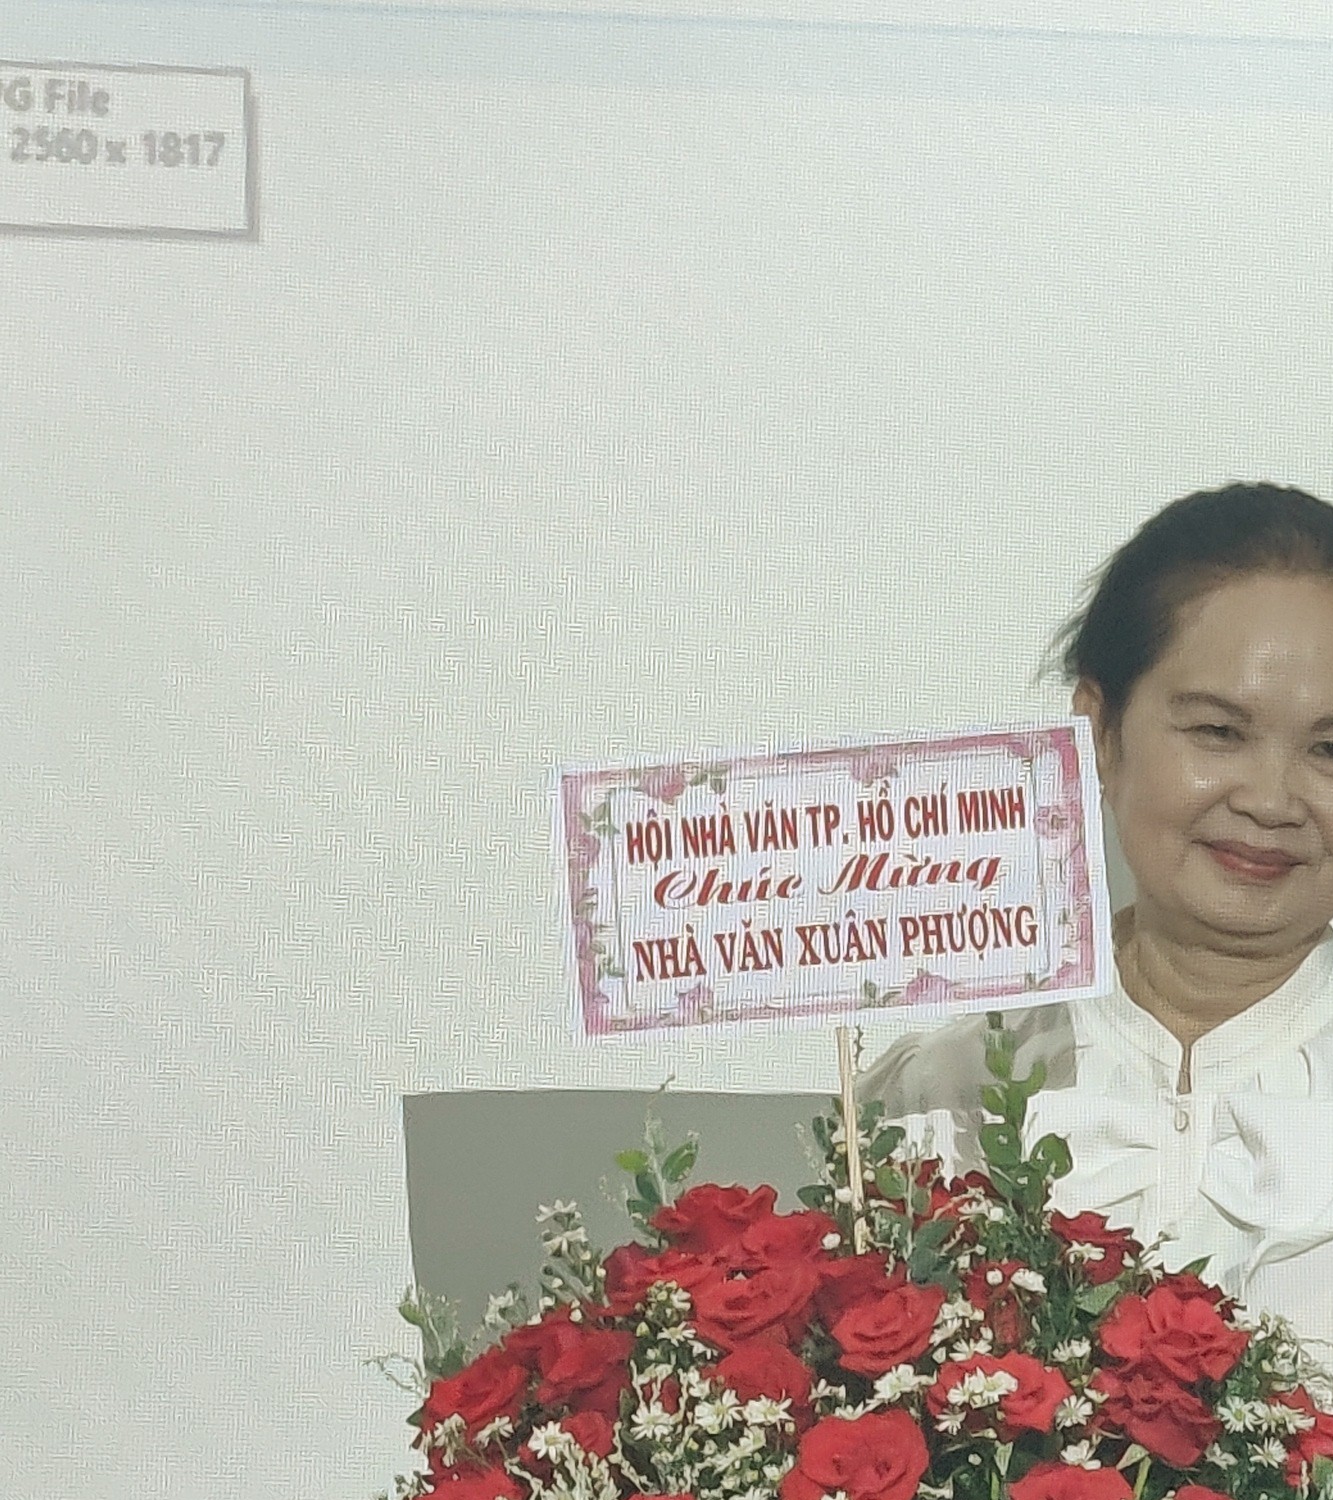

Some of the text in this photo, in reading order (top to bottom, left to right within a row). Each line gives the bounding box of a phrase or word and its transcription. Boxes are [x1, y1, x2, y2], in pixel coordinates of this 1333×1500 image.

[0, 76, 109, 116] G File
[12, 126, 225, 167] 2560 x 1817
[626, 781, 1026, 865] HỘI NHÀ VĂN TP. HỒ CHÍ MINH
[654, 853, 1003, 909] Chúc Mừng
[633, 905, 1038, 982] NHÀ VĂN XUÂN PHƯỢNG
